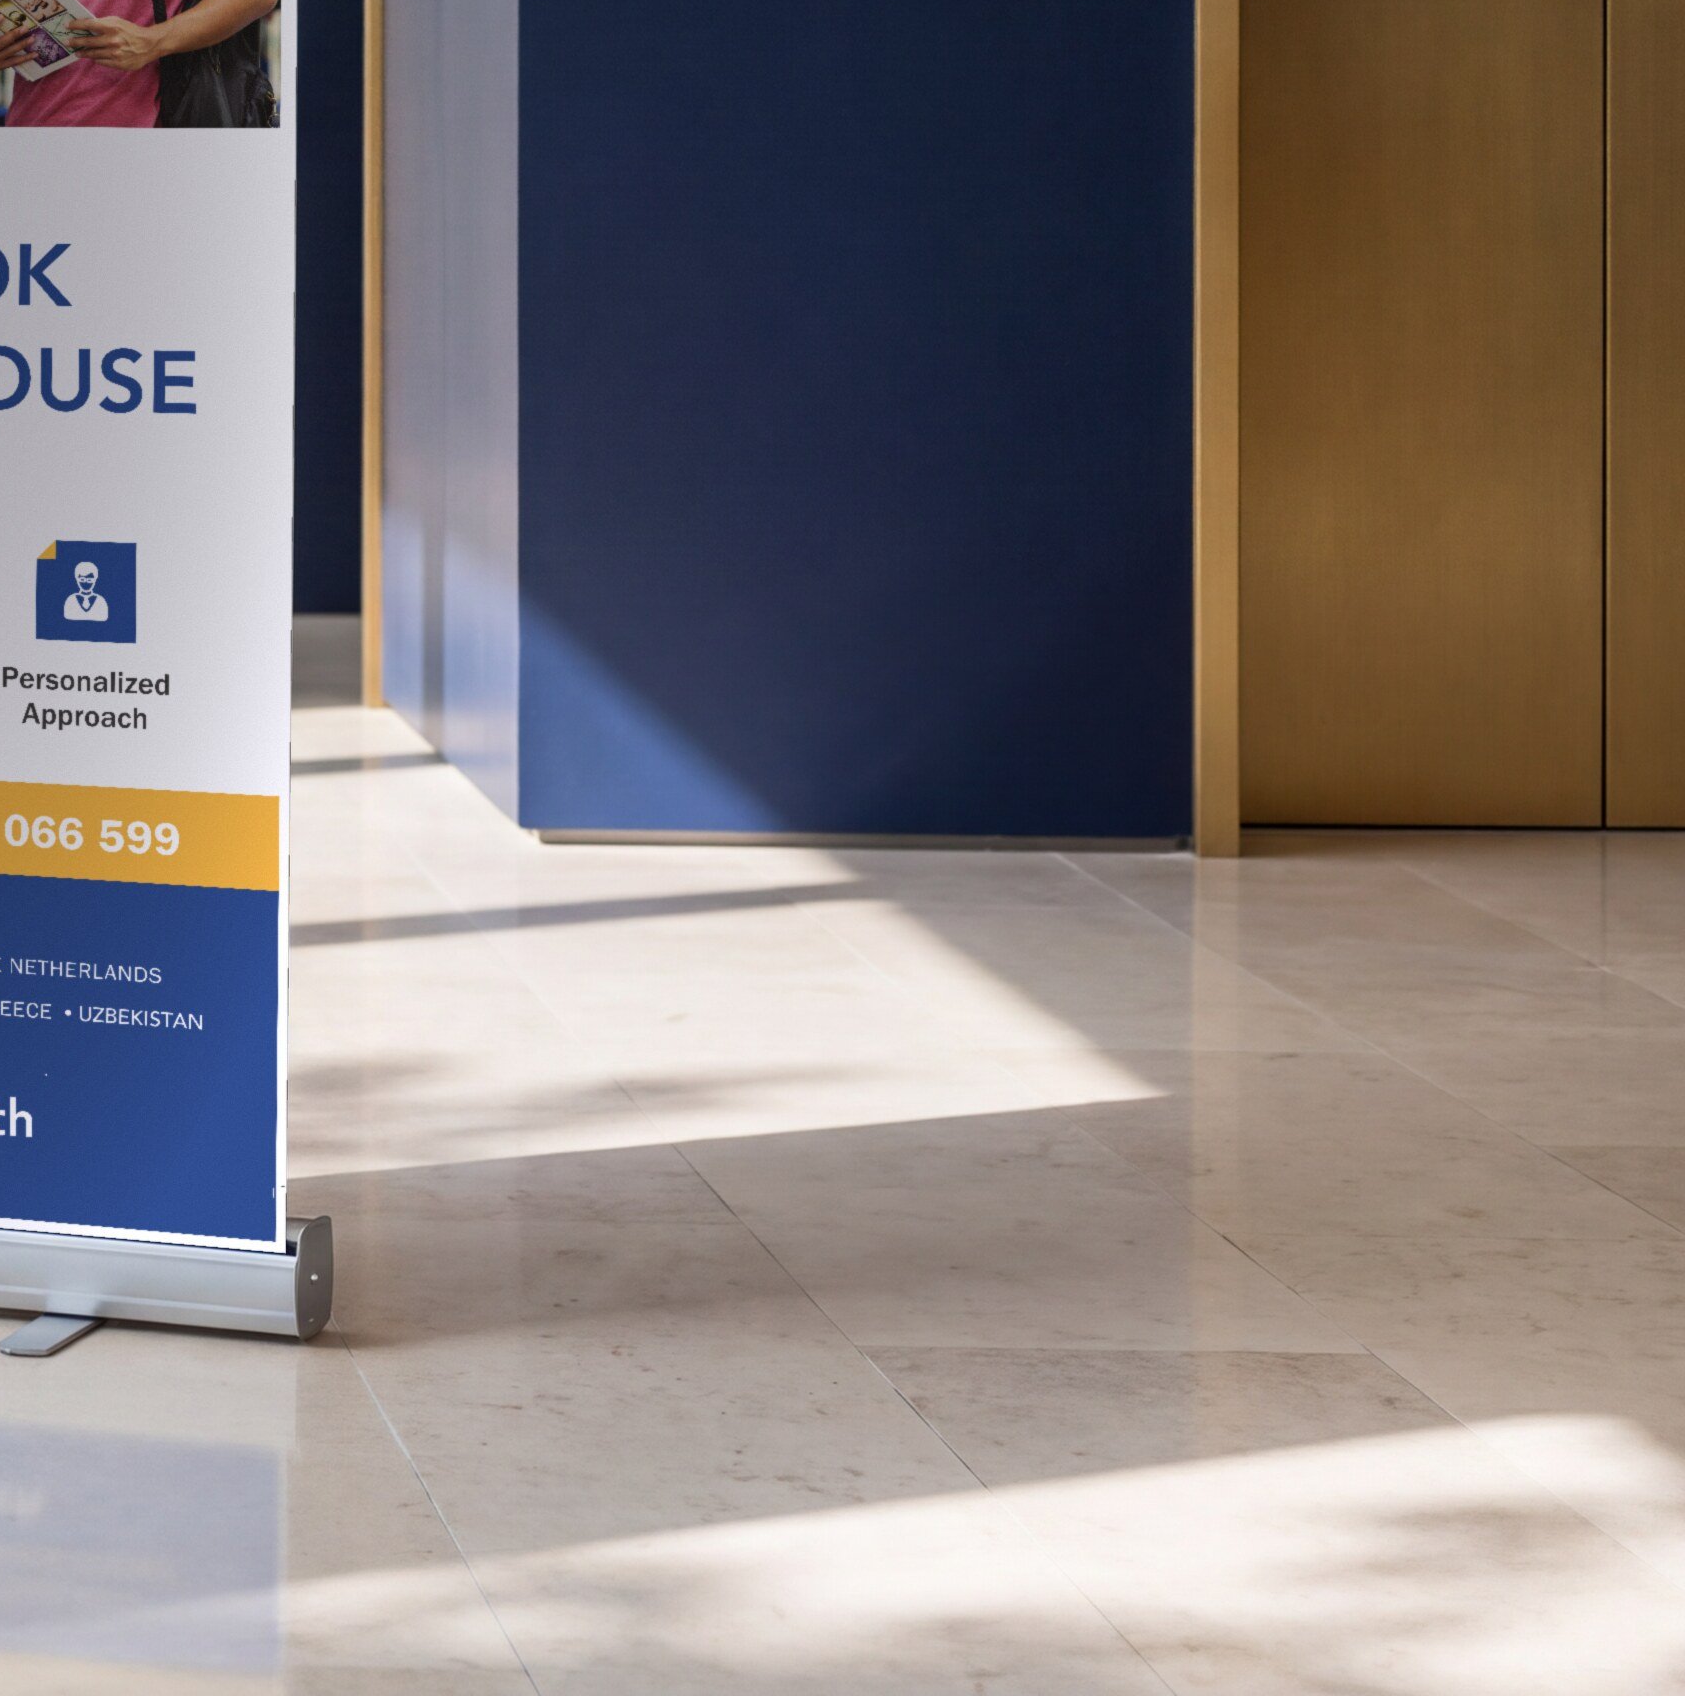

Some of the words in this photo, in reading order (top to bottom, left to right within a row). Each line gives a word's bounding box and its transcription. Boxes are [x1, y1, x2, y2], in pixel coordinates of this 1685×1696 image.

[2, 666, 170, 696] Personalized
[21, 702, 147, 731] Approach
[4, 813, 84, 851] 066
[99, 819, 181, 856] 599
[10, 958, 162, 984] NETHERLANDS
[79, 1005, 204, 1031] UZBEKISTAN
